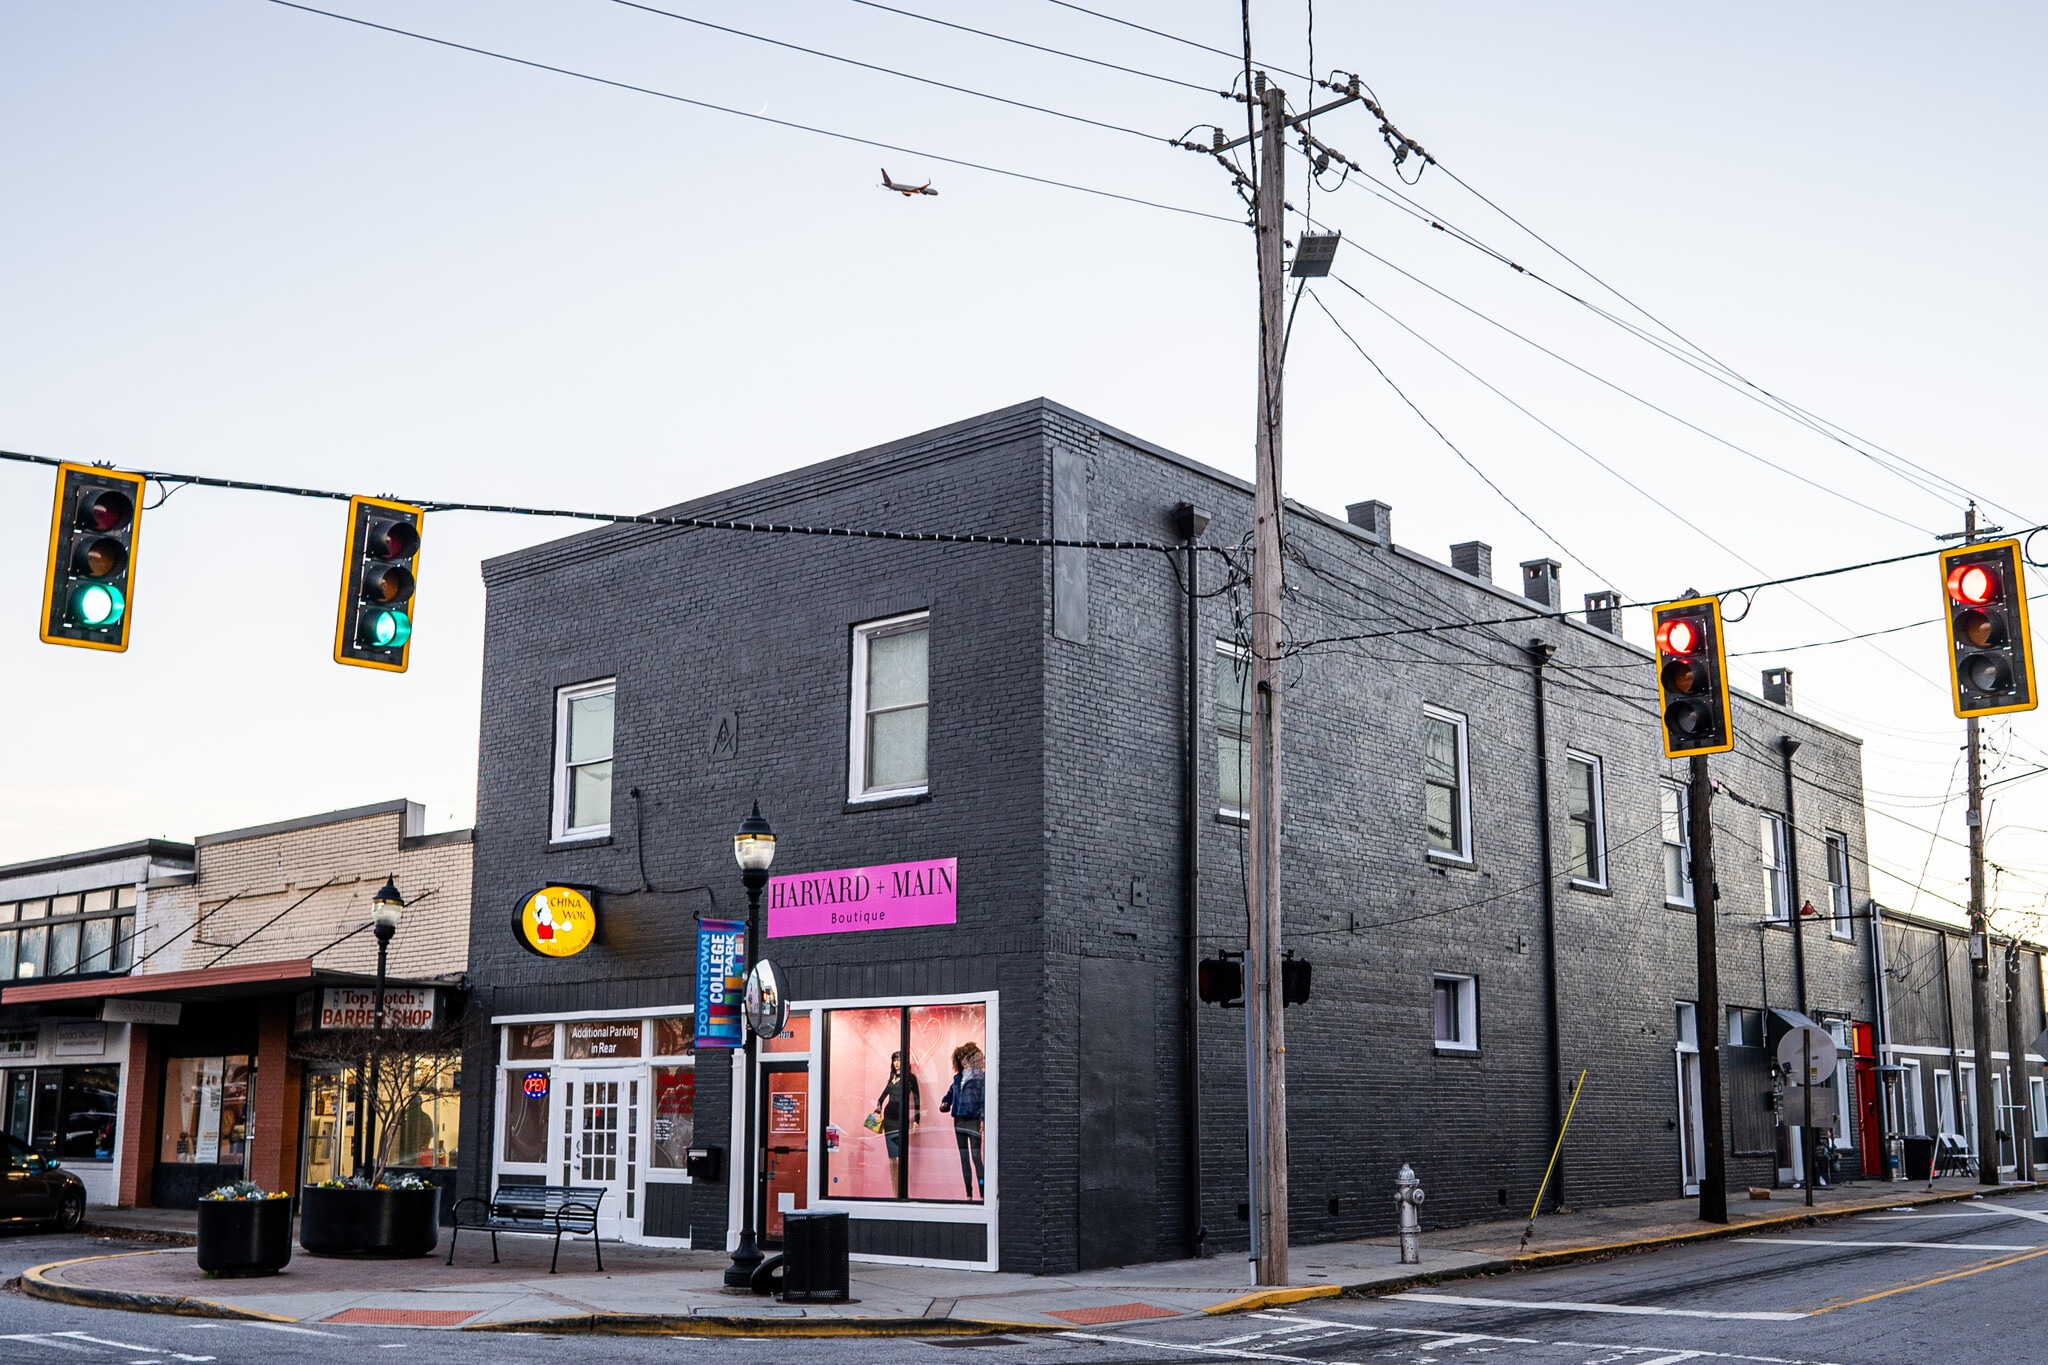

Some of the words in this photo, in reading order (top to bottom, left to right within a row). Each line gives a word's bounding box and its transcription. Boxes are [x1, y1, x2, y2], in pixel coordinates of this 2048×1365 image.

[770, 875, 869, 909] HARVARD
[876, 880, 885, 895] +
[891, 866, 954, 899] MAIN
[550, 897, 581, 908] CHINA
[562, 909, 586, 920] WOK
[831, 911, 886, 924] Boutique
[724, 934, 735, 976] PARK
[709, 933, 725, 1004] COLLEGE
[698, 934, 710, 1036] DOWNTOWN
[342, 990, 369, 1008] Top
[391, 1009, 432, 1026] SHOP
[572, 1027, 609, 1039] Additional
[609, 1026, 639, 1040] Parking
[591, 1043, 598, 1054] in
[599, 1042, 617, 1054] Rear
[523, 1078, 547, 1092] OPEN
